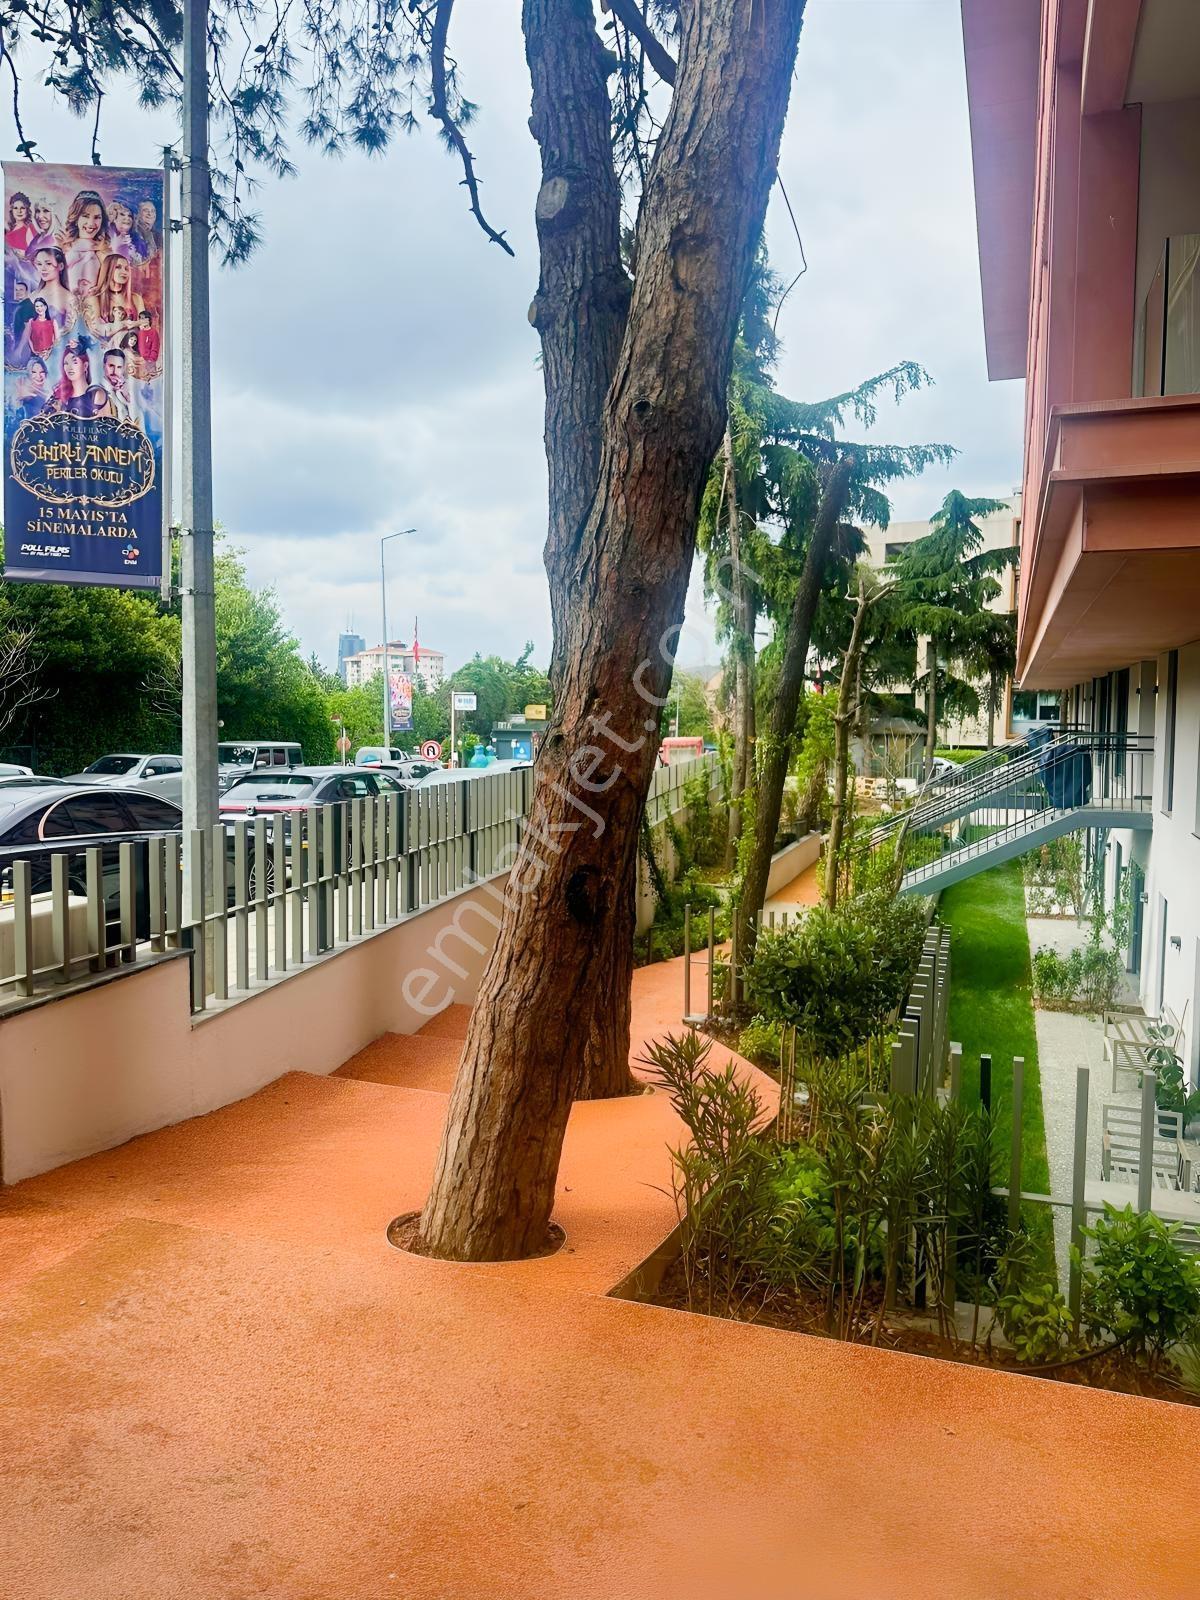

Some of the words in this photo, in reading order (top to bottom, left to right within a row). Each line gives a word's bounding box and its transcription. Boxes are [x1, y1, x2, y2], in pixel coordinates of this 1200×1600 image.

[81, 445, 142, 472] ANNEM
[90, 468, 124, 484] OKULU
[39, 507, 54, 518] 15
[57, 508, 128, 523] MAYIS'TA
[27, 519, 139, 538] SİNEMALARDA
[21, 543, 43, 552] POLL
[44, 546, 71, 554] FILMS
